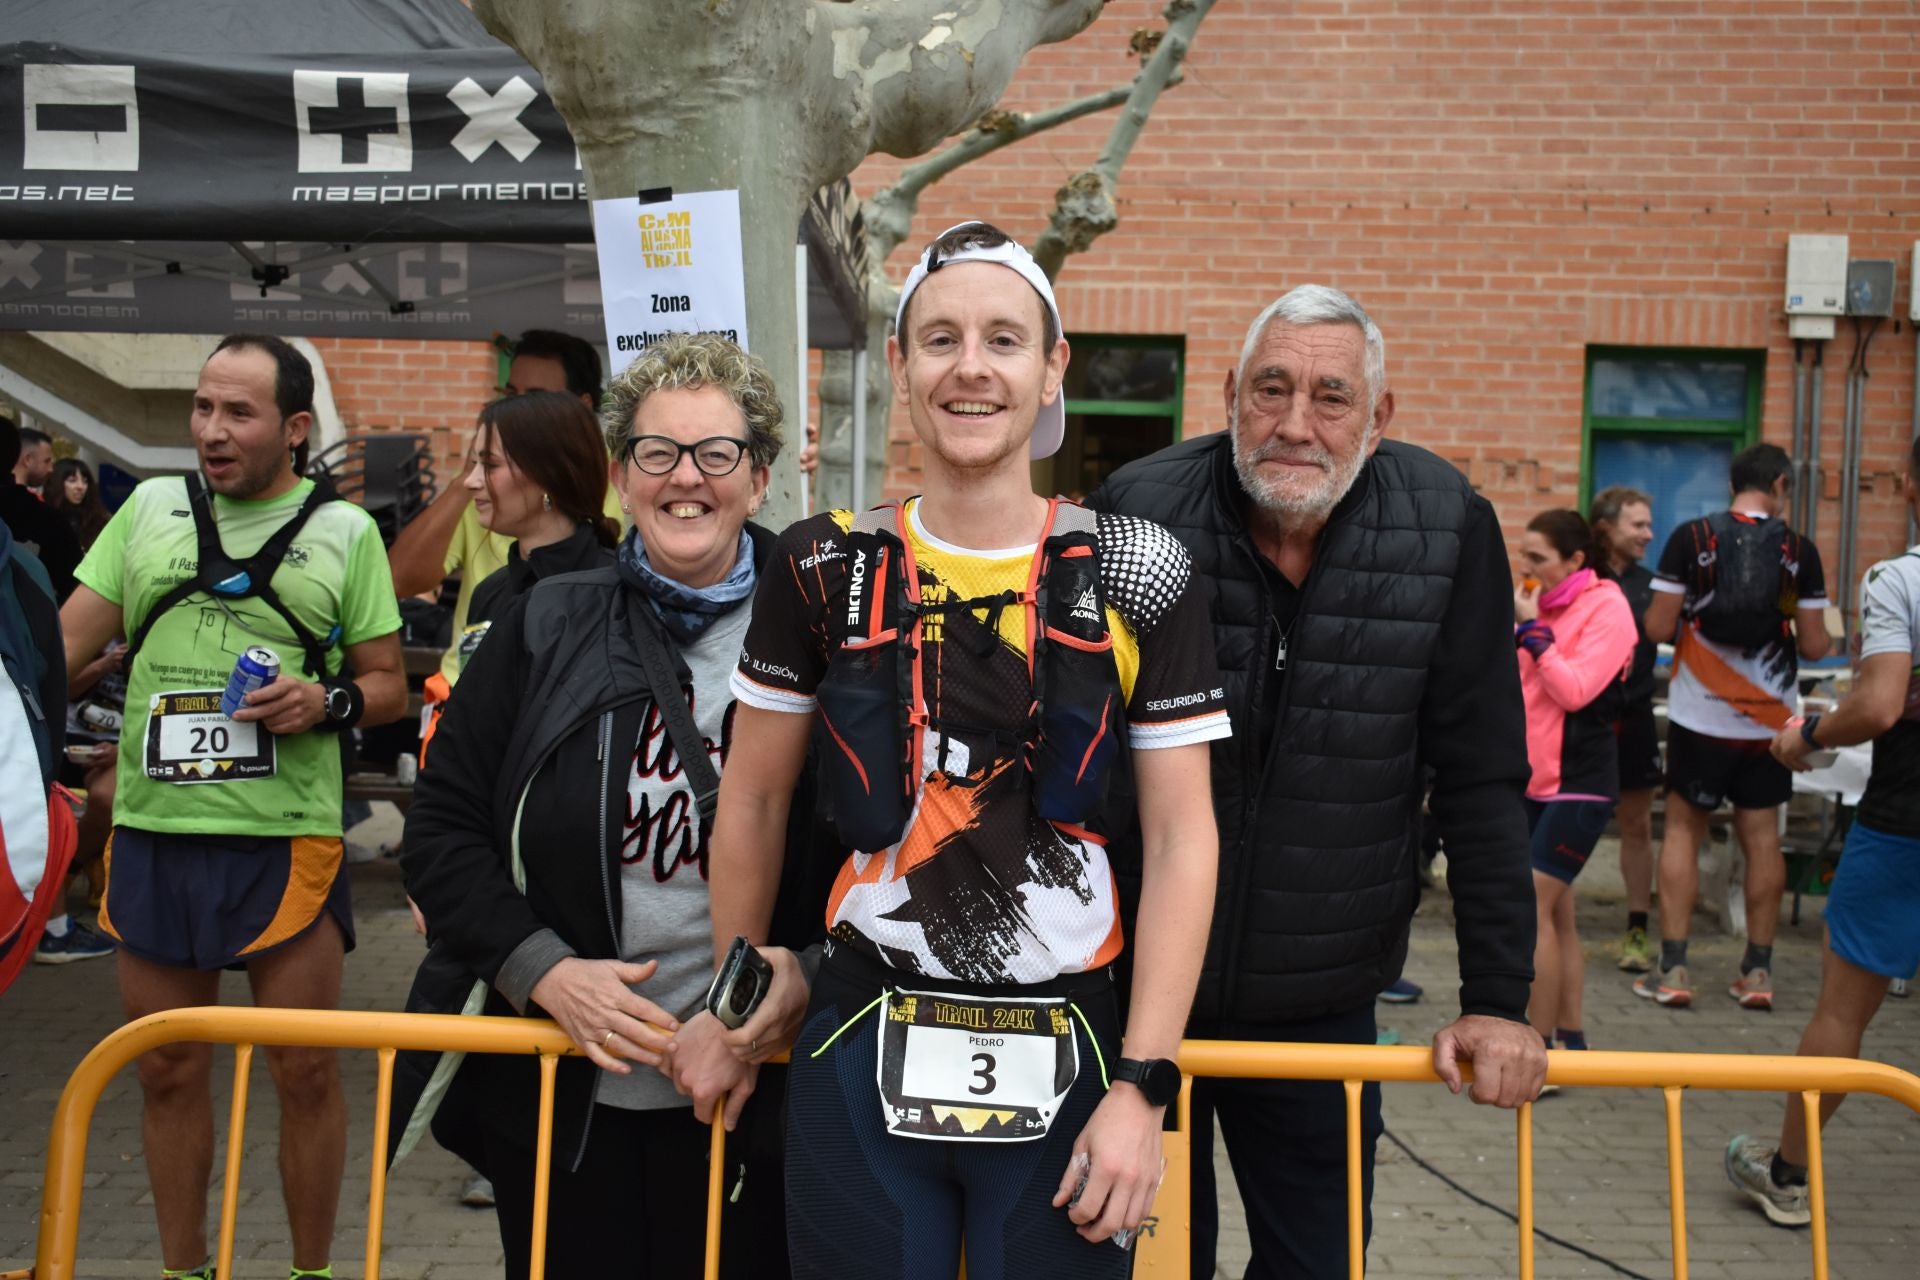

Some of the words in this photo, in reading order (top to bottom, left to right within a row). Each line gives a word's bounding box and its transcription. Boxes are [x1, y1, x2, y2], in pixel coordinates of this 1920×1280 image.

[651, 294, 691, 313] Zona
[177, 557, 199, 571] Pas
[752, 659, 799, 682] ILUSIÓN
[174, 697, 209, 711] TRAIL
[211, 696, 222, 710] 2
[1146, 692, 1206, 711] SEGURIDAD
[1210, 687, 1224, 700] RES
[98, 712, 115, 728] 70
[189, 727, 229, 754] 20
[935, 1002, 988, 1027] TRAIL
[993, 1008, 1035, 1030] 24K
[969, 1036, 1004, 1047] PEDRO
[968, 1052, 997, 1095] 3
[1026, 1118, 1046, 1130] b.p
